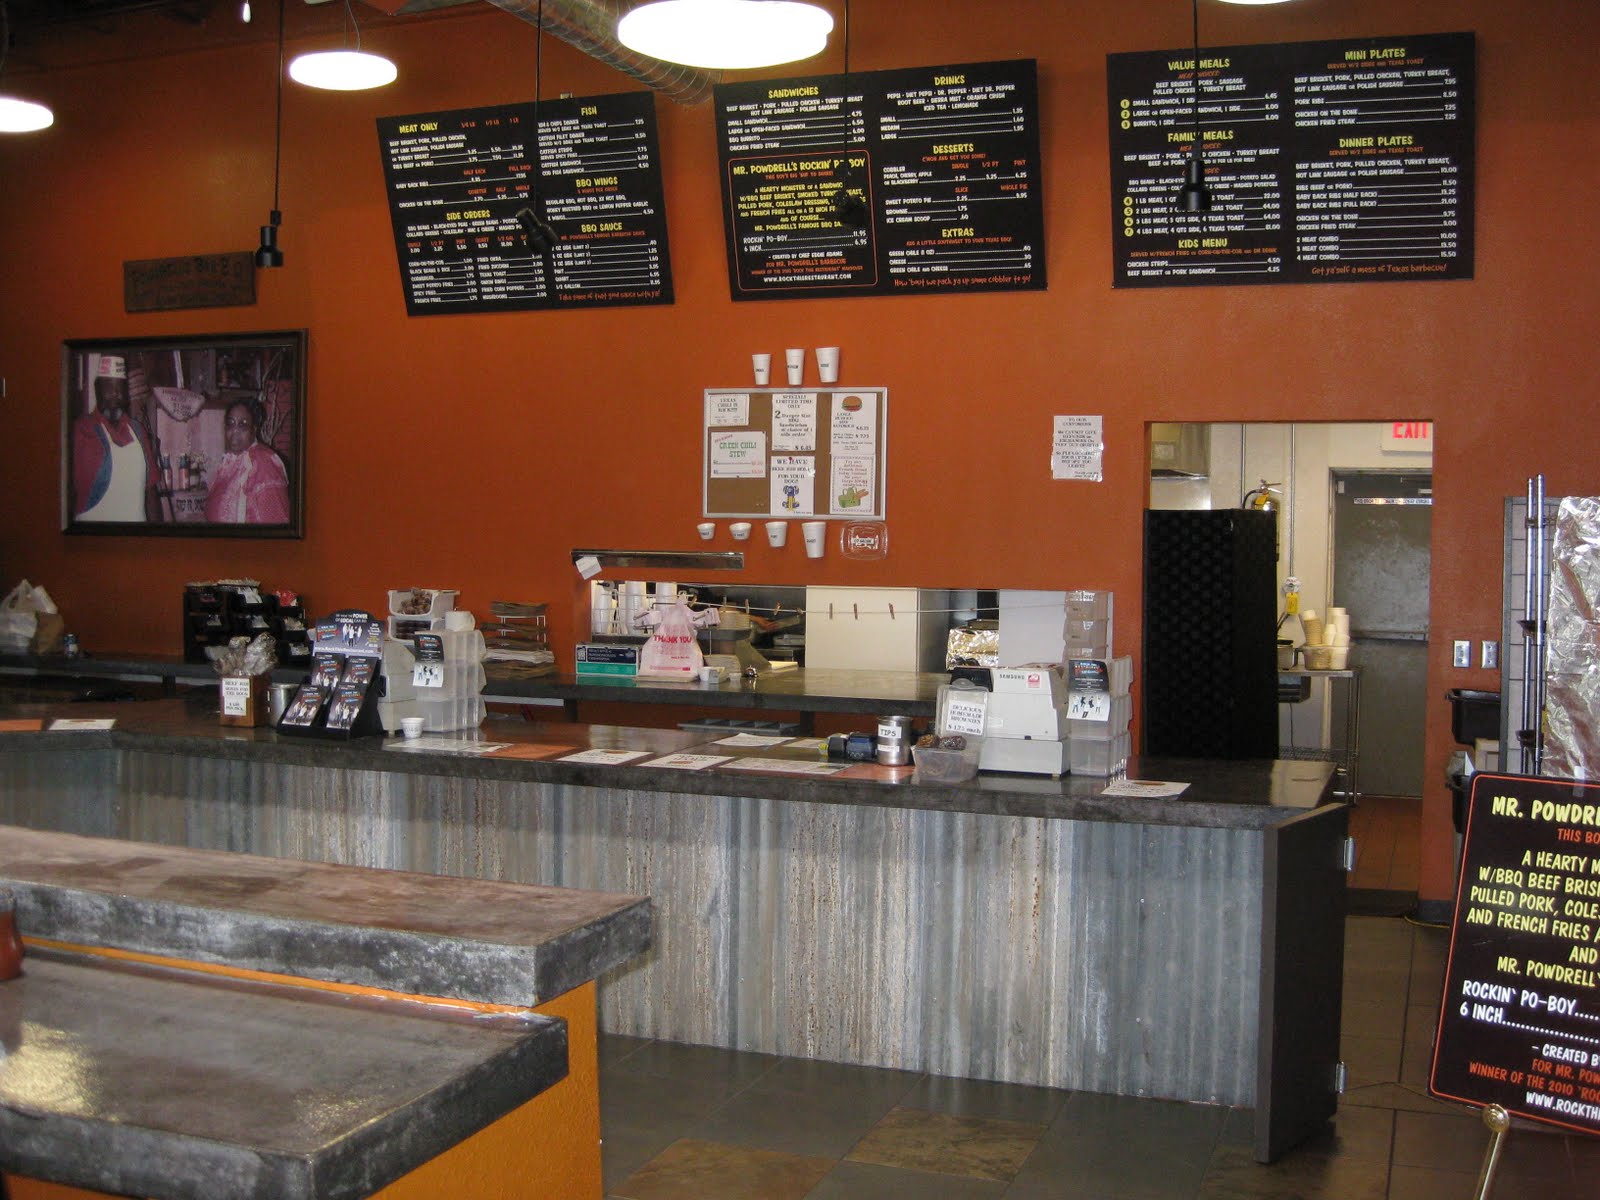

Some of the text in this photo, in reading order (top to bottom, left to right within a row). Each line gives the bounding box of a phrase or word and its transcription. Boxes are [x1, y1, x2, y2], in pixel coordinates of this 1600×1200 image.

[1345, 48, 1406, 61] MINI PLATES
[1168, 59, 1230, 70] VALUE MEALS
[934, 75, 965, 86] DRINKS
[768, 87, 819, 99] SANDWICHES
[581, 106, 597, 116] FISH
[399, 122, 438, 133] MEAT ONLY
[1204, 130, 1234, 140] MEALS
[1339, 136, 1413, 148] DINNER PLATES
[933, 144, 974, 154] DESSERTS
[733, 165, 749, 175] MR.
[750, 162, 797, 173] POWDRELL'S
[800, 159, 832, 170] ROCKIN'
[576, 177, 618, 187] BBQ WINGS
[446, 210, 491, 221] SIDE ORDERS
[581, 222, 622, 233] BBQ SAUCE
[942, 228, 974, 238] EXTRAS
[1178, 238, 1228, 248] KIDS MENU
[775, 410, 780, 418] 2
[1492, 796, 1524, 818] MR.
[1558, 828, 1581, 842] THIS
[1522, 850, 1531, 866] A
[1536, 851, 1587, 873] HEARTY
[1479, 866, 1523, 888] W/BBQ
[1528, 873, 1561, 891] BEEF
[1470, 886, 1600, 919] PULLED PORK, COLE
[1466, 908, 1590, 941] AND FRENCH FRIES
[1569, 946, 1598, 964] AND
[1497, 956, 1520, 974] MR.
[1460, 1002, 1468, 1016] 6
[1542, 1044, 1600, 1067] CREATED B
[1532, 1059, 1552, 1074] FOR
[1556, 1064, 1575, 1080] MR.
[1469, 1062, 1507, 1081] WINNER
[1511, 1071, 1523, 1083] OF
[1527, 1075, 1544, 1089] THE
[1548, 1080, 1573, 1095] 2010
